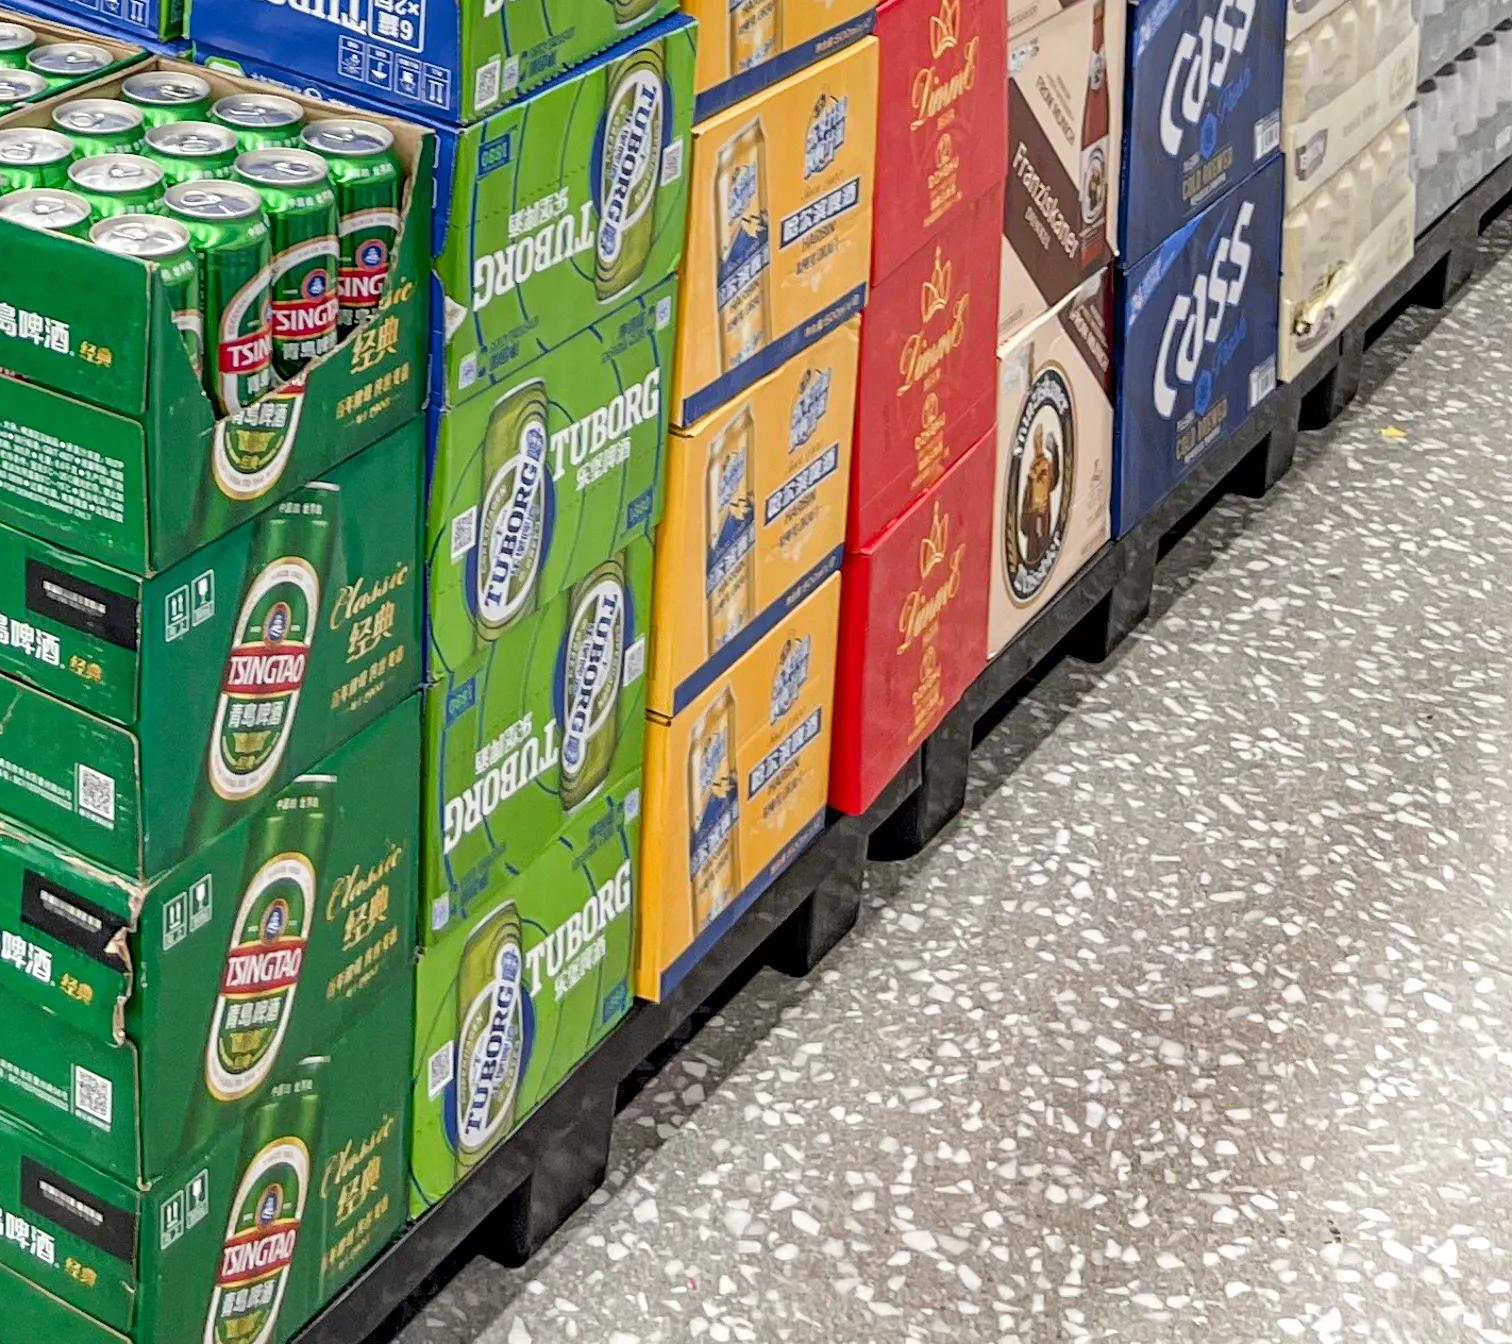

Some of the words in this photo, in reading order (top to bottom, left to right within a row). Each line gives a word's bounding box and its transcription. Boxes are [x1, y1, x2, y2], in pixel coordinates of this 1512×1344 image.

[607, 83, 657, 224] TUBORG
[1012, 141, 1080, 259] Franziskaner
[474, 201, 594, 312] TUBORG
[351, 314, 399, 375] 经典
[550, 368, 660, 482] TUBORG
[484, 458, 540, 609] TUBORG
[227, 653, 307, 686] TSINGTAO
[346, 600, 398, 664] 经典
[566, 593, 619, 748] TUBORG
[229, 701, 284, 729] 青岛啤酒
[444, 720, 558, 855] TUBORG
[225, 948, 303, 990] TSINGTAO
[526, 858, 632, 999] TUBORG
[465, 986, 515, 1135] TUBORG
[221, 1230, 299, 1277] TSINGTAO
